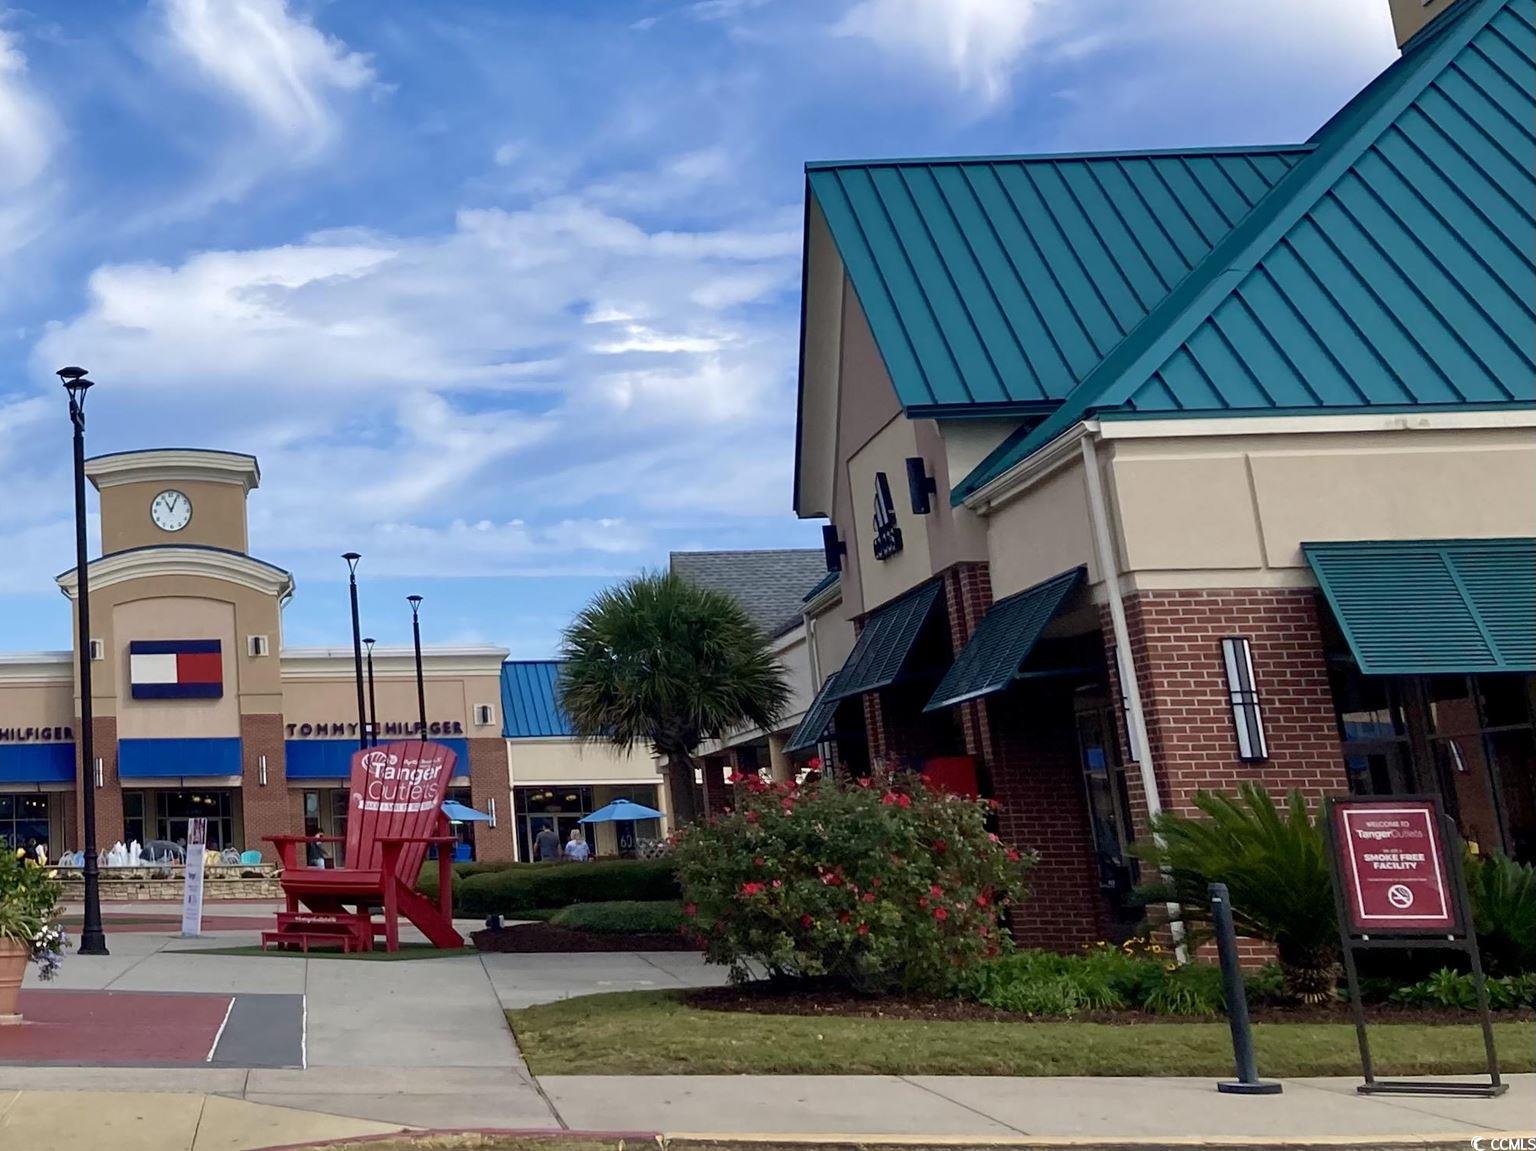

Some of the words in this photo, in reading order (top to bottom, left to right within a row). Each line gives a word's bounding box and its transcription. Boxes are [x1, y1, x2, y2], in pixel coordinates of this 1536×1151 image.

[0, 726, 75, 741] HILFIGER
[286, 723, 358, 737] TOMMY
[385, 721, 464, 736] HILFGER
[371, 761, 443, 786] Tanger
[368, 780, 439, 801] Outlets
[1363, 853, 1399, 862] SMOKE
[1400, 853, 1426, 862] FREE
[1373, 861, 1417, 870] FACILITY
